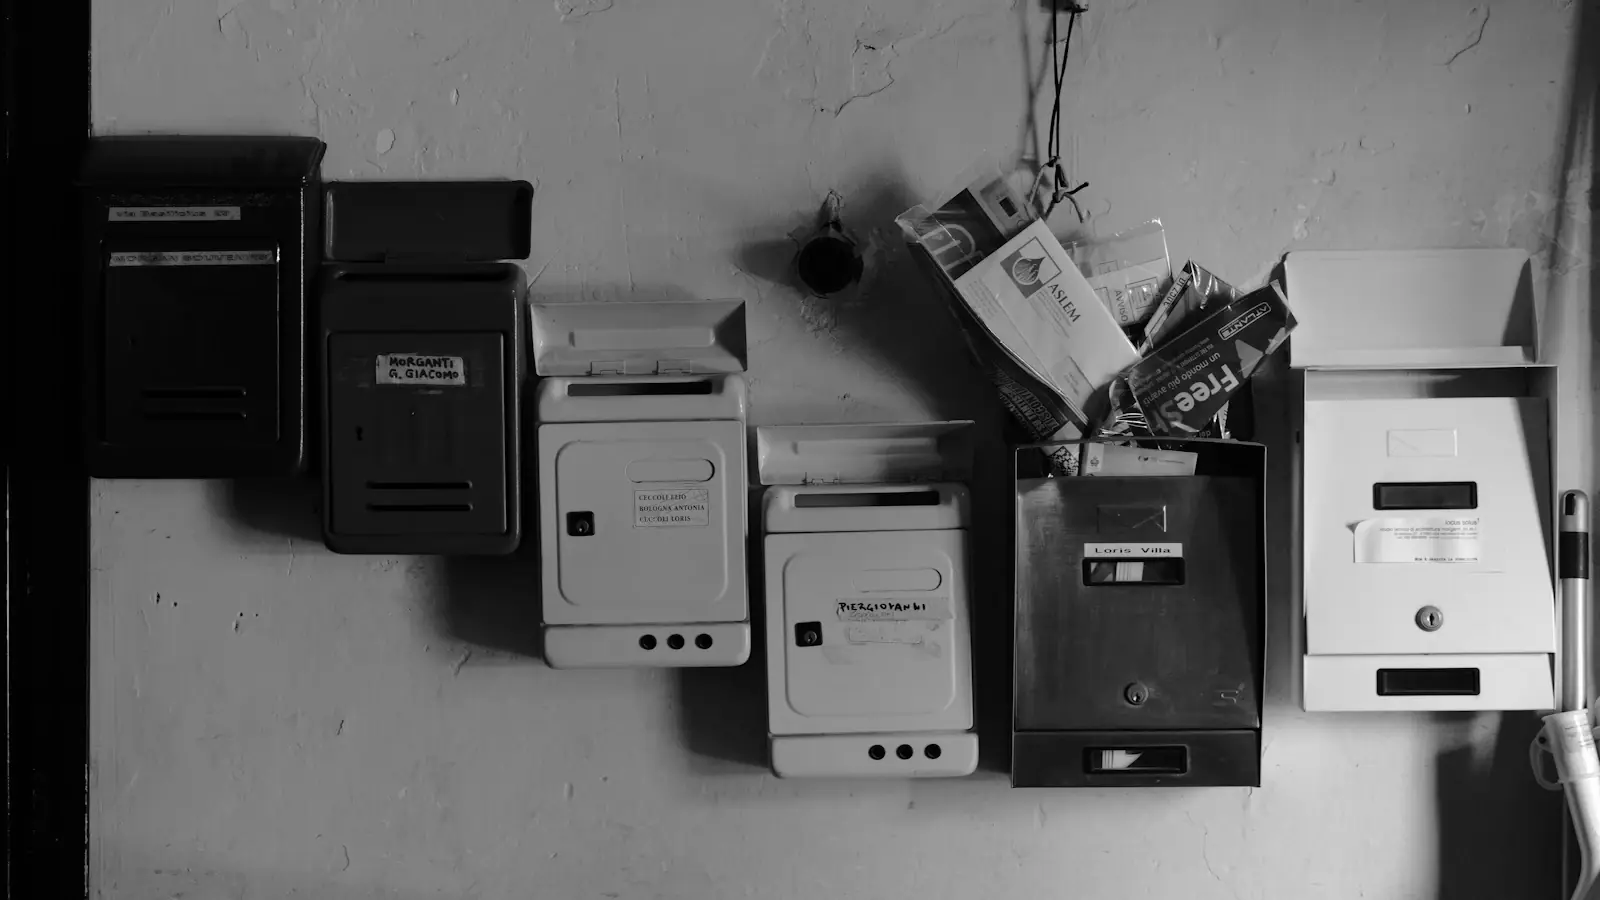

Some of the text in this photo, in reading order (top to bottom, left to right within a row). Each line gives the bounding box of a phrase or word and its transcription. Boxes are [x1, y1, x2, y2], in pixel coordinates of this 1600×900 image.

[1048, 283, 1082, 323] ASLEM
[1114, 290, 1129, 322] AVVISO
[1221, 305, 1268, 339] ATLANTE
[389, 357, 454, 369] MORGANTI
[1209, 352, 1221, 363] un
[389, 368, 460, 380] G. GIACOMO
[1181, 359, 1210, 382] mondo
